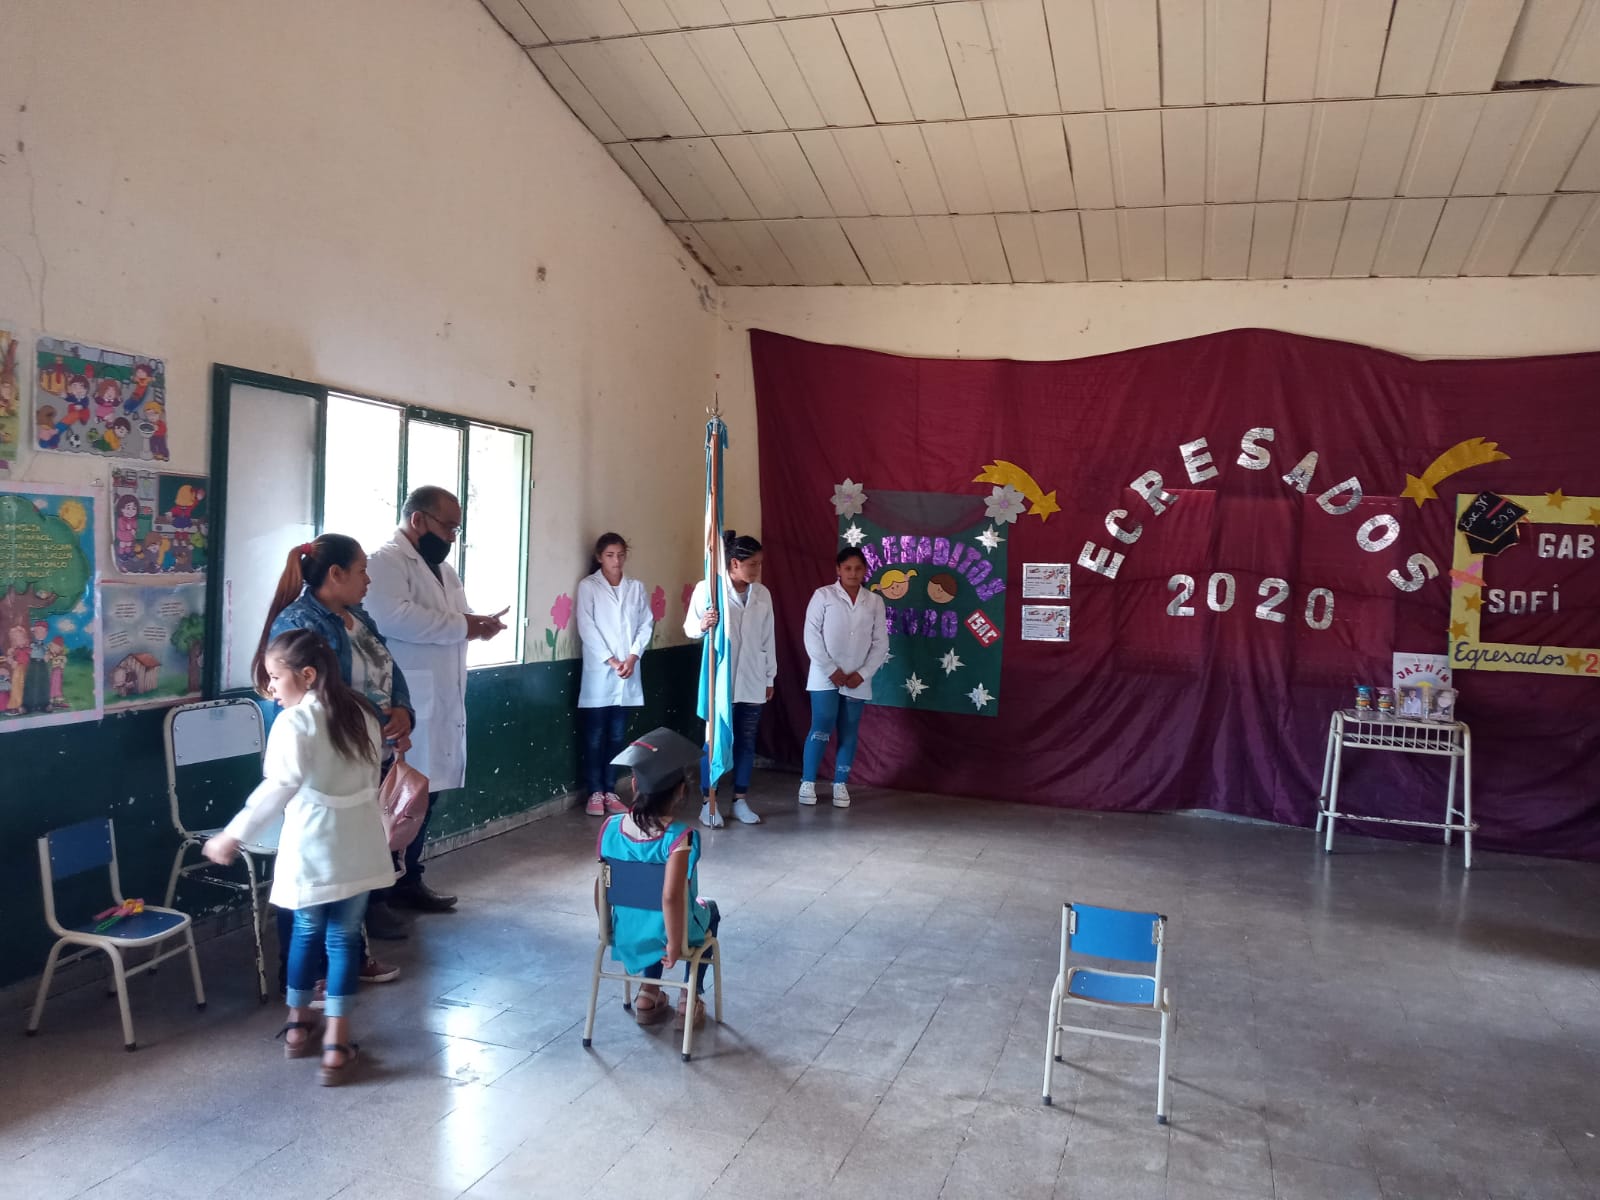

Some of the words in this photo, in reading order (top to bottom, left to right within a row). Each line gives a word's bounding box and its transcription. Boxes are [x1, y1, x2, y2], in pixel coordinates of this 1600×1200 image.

[862, 535, 1006, 601] RESADITOS
[1167, 572, 1335, 630] 2020
[1454, 641, 1565, 670] Egresados
